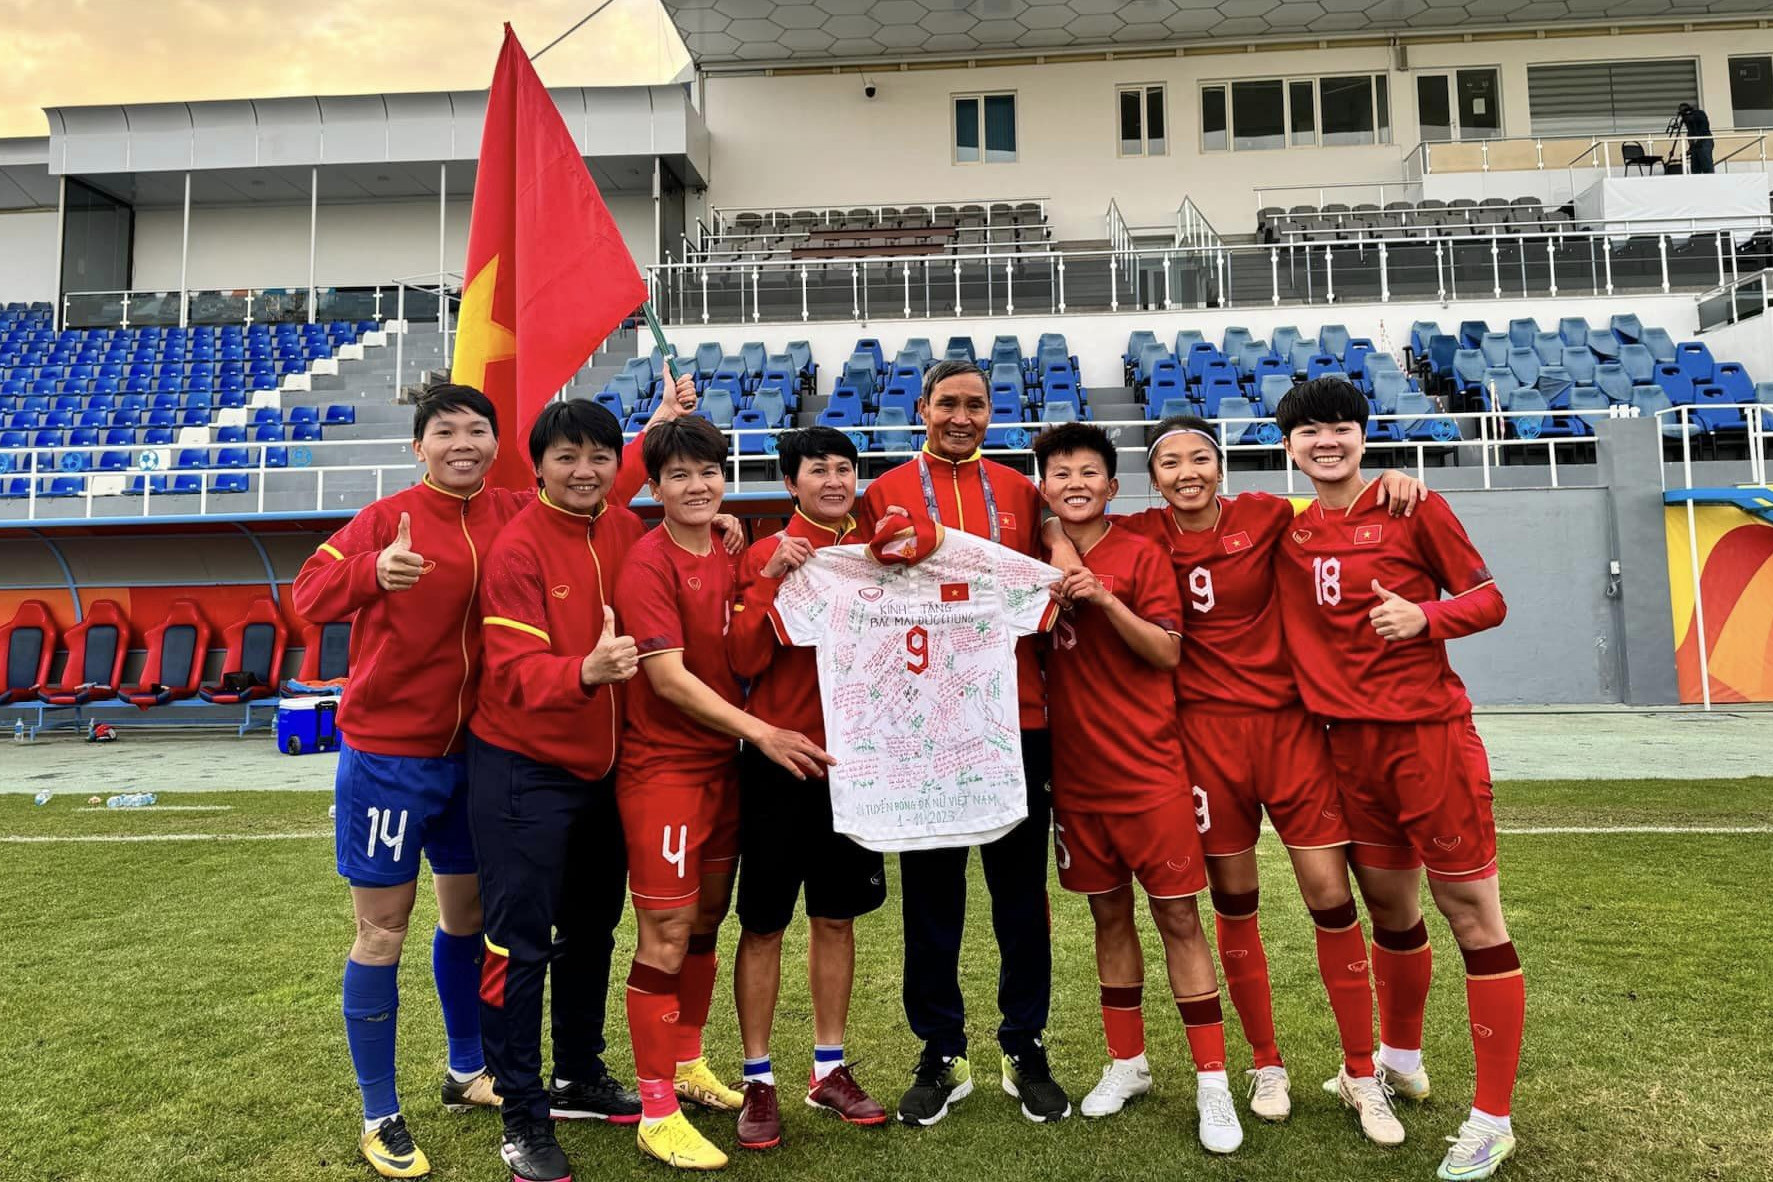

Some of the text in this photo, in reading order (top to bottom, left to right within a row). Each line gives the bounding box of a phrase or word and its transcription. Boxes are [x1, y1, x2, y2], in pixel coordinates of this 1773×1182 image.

[1189, 566, 1215, 613] 9
[1312, 557, 1341, 606] 18
[894, 616, 914, 626] MAI
[906, 625, 928, 675] 9
[1192, 785, 1211, 833] 9
[367, 806, 408, 862] 14
[662, 824, 687, 879] 4
